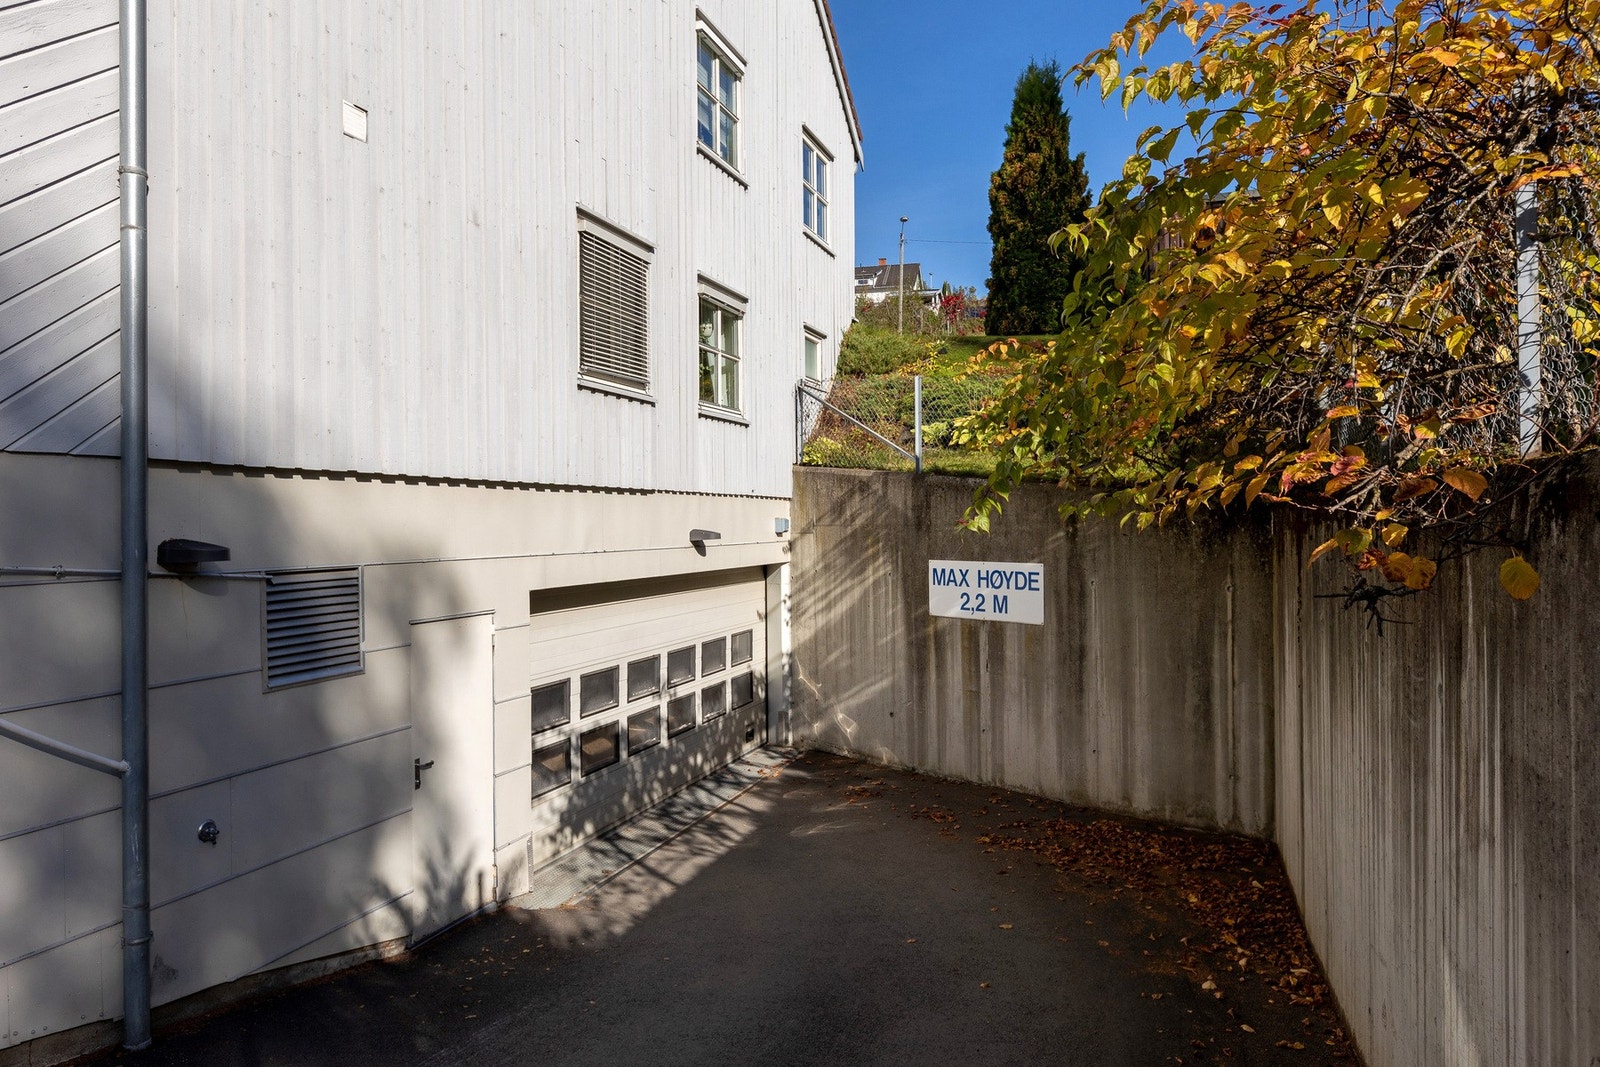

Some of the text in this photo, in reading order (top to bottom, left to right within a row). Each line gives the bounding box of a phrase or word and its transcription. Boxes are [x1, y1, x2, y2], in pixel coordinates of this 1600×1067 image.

[932, 567, 1040, 592] MAX HØYDE
[960, 592, 1008, 615] 2,2 M
